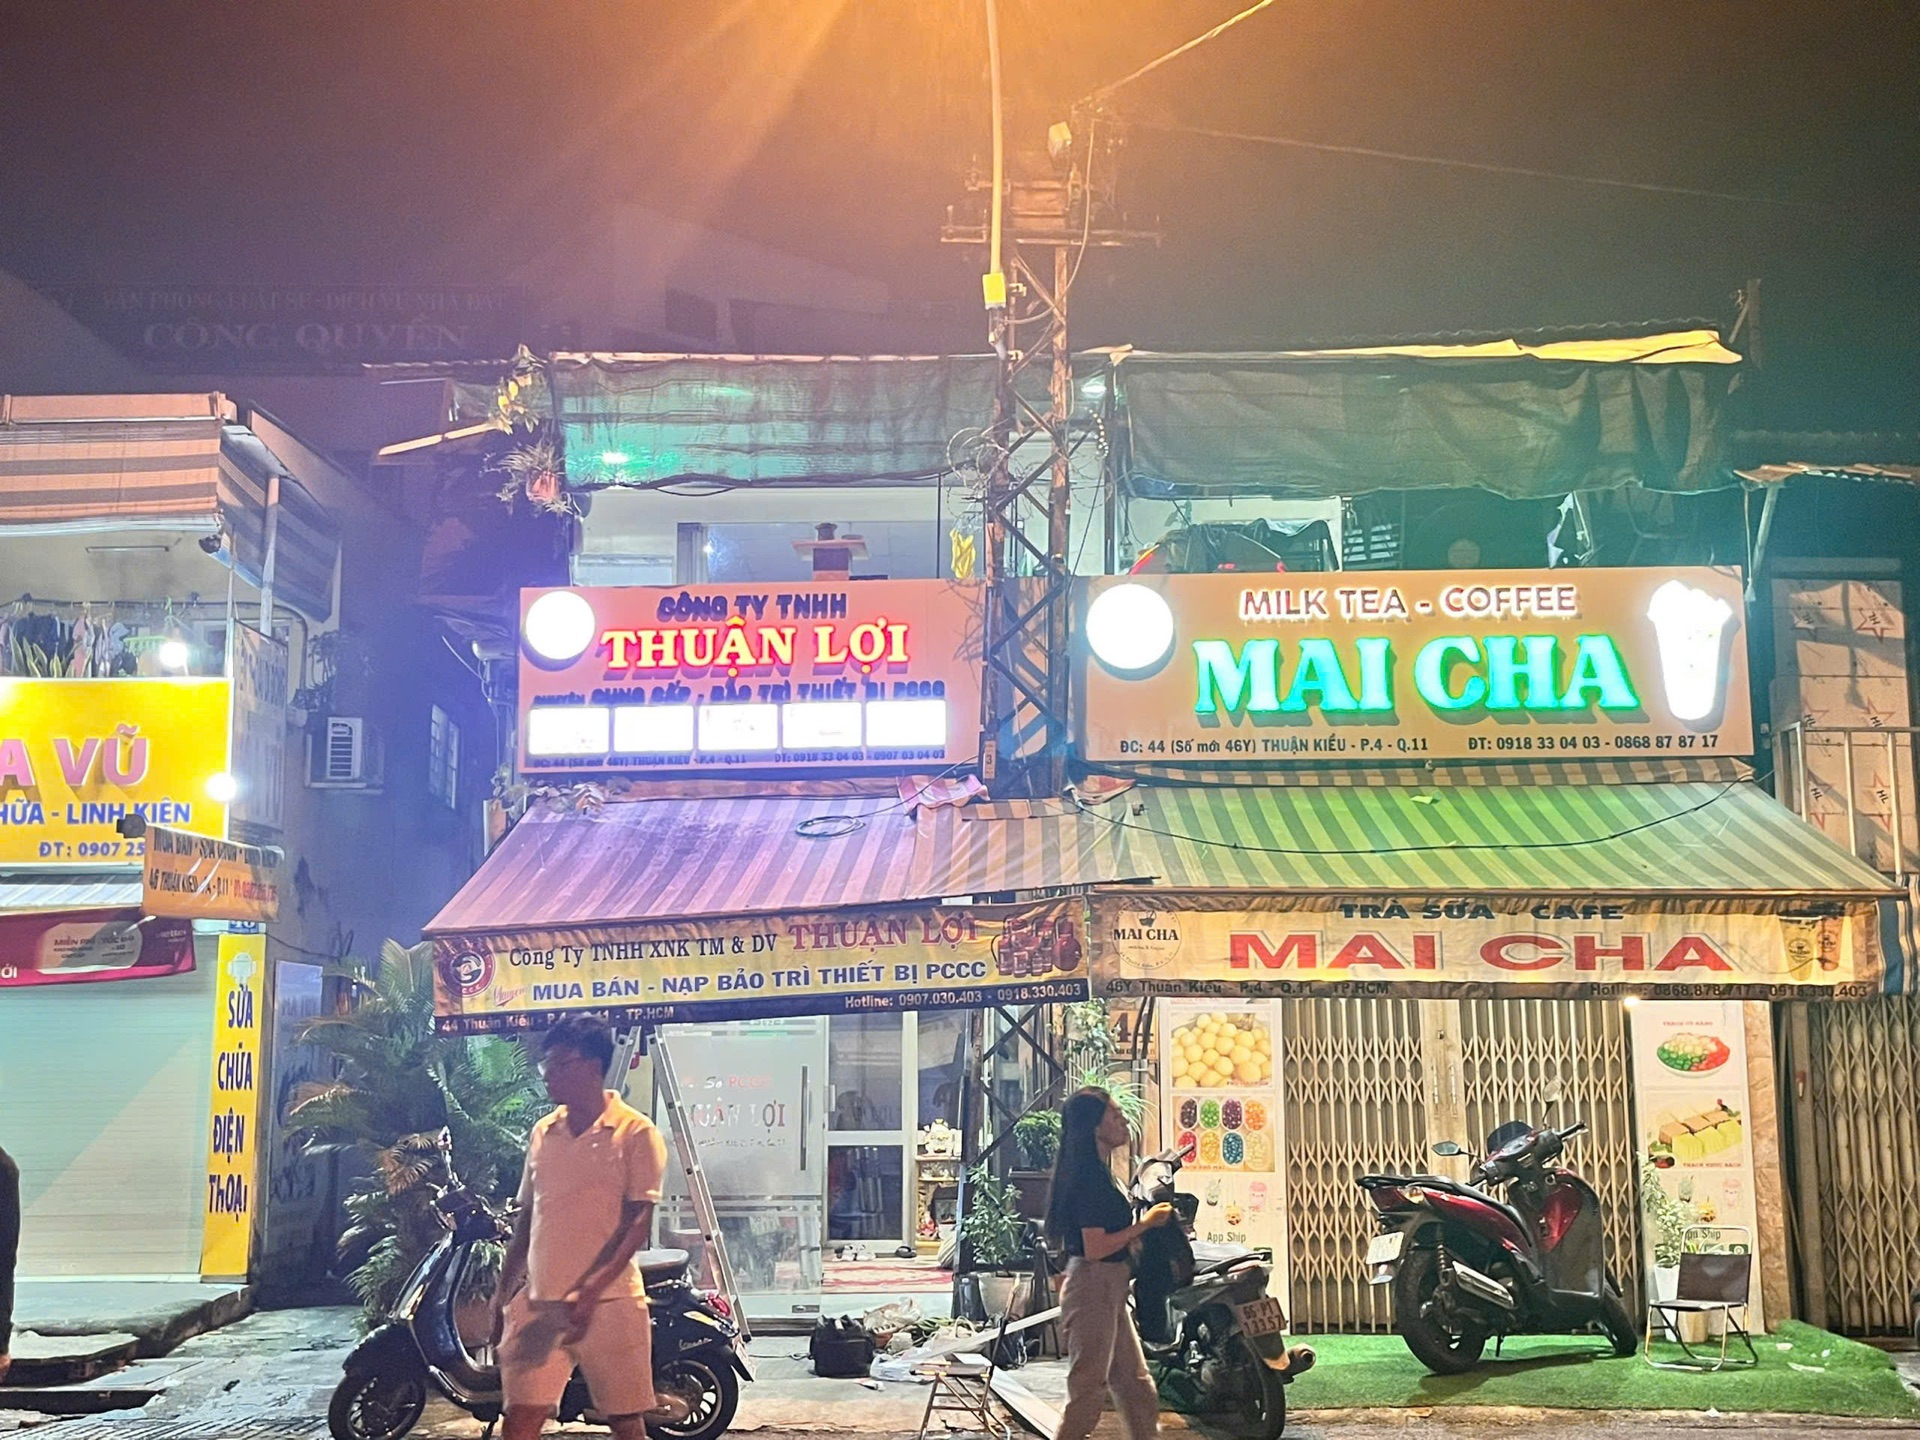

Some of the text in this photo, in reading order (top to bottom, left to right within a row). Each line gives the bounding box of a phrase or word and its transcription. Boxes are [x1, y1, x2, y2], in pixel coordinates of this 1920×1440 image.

[734, 594, 768, 619] TY
[776, 593, 847, 618] TNHH
[1242, 586, 1579, 617] MILK TEA COFFEE
[599, 616, 910, 678] THUẬN LỢI
[1192, 633, 1640, 713] MAI CHA
[53, 722, 149, 787] VŨ
[1120, 740, 1143, 754] ĐC:
[1147, 740, 1166, 753] 44
[1171, 737, 1194, 754] (Số
[1197, 740, 1221, 753] mới
[1225, 739, 1256, 754] 46Y)
[1262, 737, 1309, 754] THUẬN
[1361, 738, 1383, 751] P.4
[1397, 738, 1428, 753] Q.11
[1468, 735, 1718, 750] ĐT: 0918 33 04 03 0868 87 87 17
[793, 751, 818, 763] 0918
[820, 751, 833, 763] 33
[836, 751, 850, 762] 04
[852, 751, 865, 762] 03
[874, 750, 899, 762] 0907
[901, 750, 915, 762] 03
[917, 750, 931, 761] 04
[933, 749, 946, 761] 03
[67, 802, 126, 825] LINH
[78, 841, 122, 858] 0907
[1343, 900, 1410, 920] TRÀ
[1531, 905, 1625, 921] CAFE
[561, 945, 584, 967] Ty
[590, 940, 644, 962] TNHH
[649, 937, 690, 959] XNK
[696, 935, 725, 956] TM
[731, 935, 745, 954] &
[752, 933, 778, 953] DV
[788, 913, 908, 954] THUẬN
[920, 910, 980, 950] LỢI
[1113, 928, 1179, 941] MAI CHA
[1229, 933, 1733, 971] MAI CHA
[532, 983, 584, 1001] MUA
[591, 977, 640, 997] BÁN
[662, 976, 709, 996] NẠP
[717, 967, 765, 991] BẢO
[771, 965, 810, 988] TRÌ
[817, 960, 885, 985] THIẾT
[894, 963, 919, 985] BỊ
[926, 961, 987, 980] PCCC
[1105, 981, 1132, 993] 46Y
[1240, 981, 1263, 993] P.4
[228, 983, 253, 1029] SỬA
[845, 982, 1082, 1010] Hotline: 0907.030.403 0918.330.403
[625, 1005, 675, 1021] TP.HCM
[213, 1107, 245, 1164] ĐIỆN
[1207, 1231, 1247, 1244] App Ship
